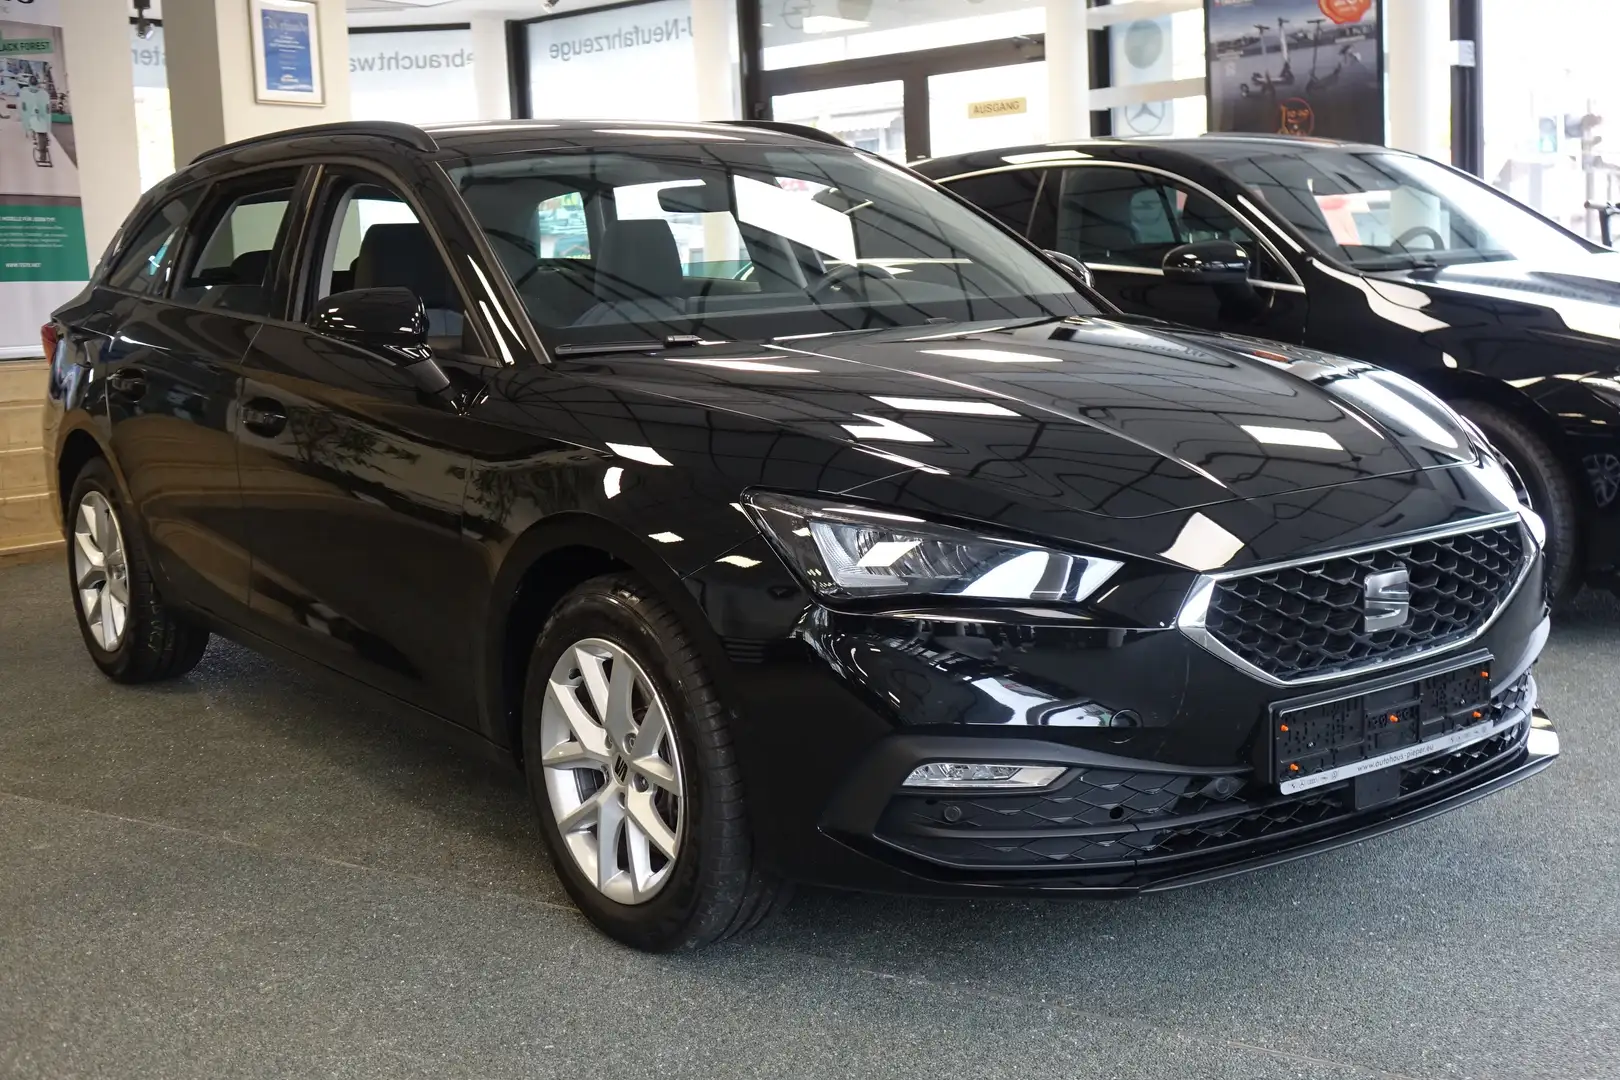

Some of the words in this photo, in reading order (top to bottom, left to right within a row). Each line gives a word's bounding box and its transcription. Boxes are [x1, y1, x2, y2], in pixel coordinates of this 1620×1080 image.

[20, 41, 50, 51] FOREST
[973, 101, 1020, 114] AUSGANG
[1357, 743, 1434, 772] www.autohaus-pieper.eu
